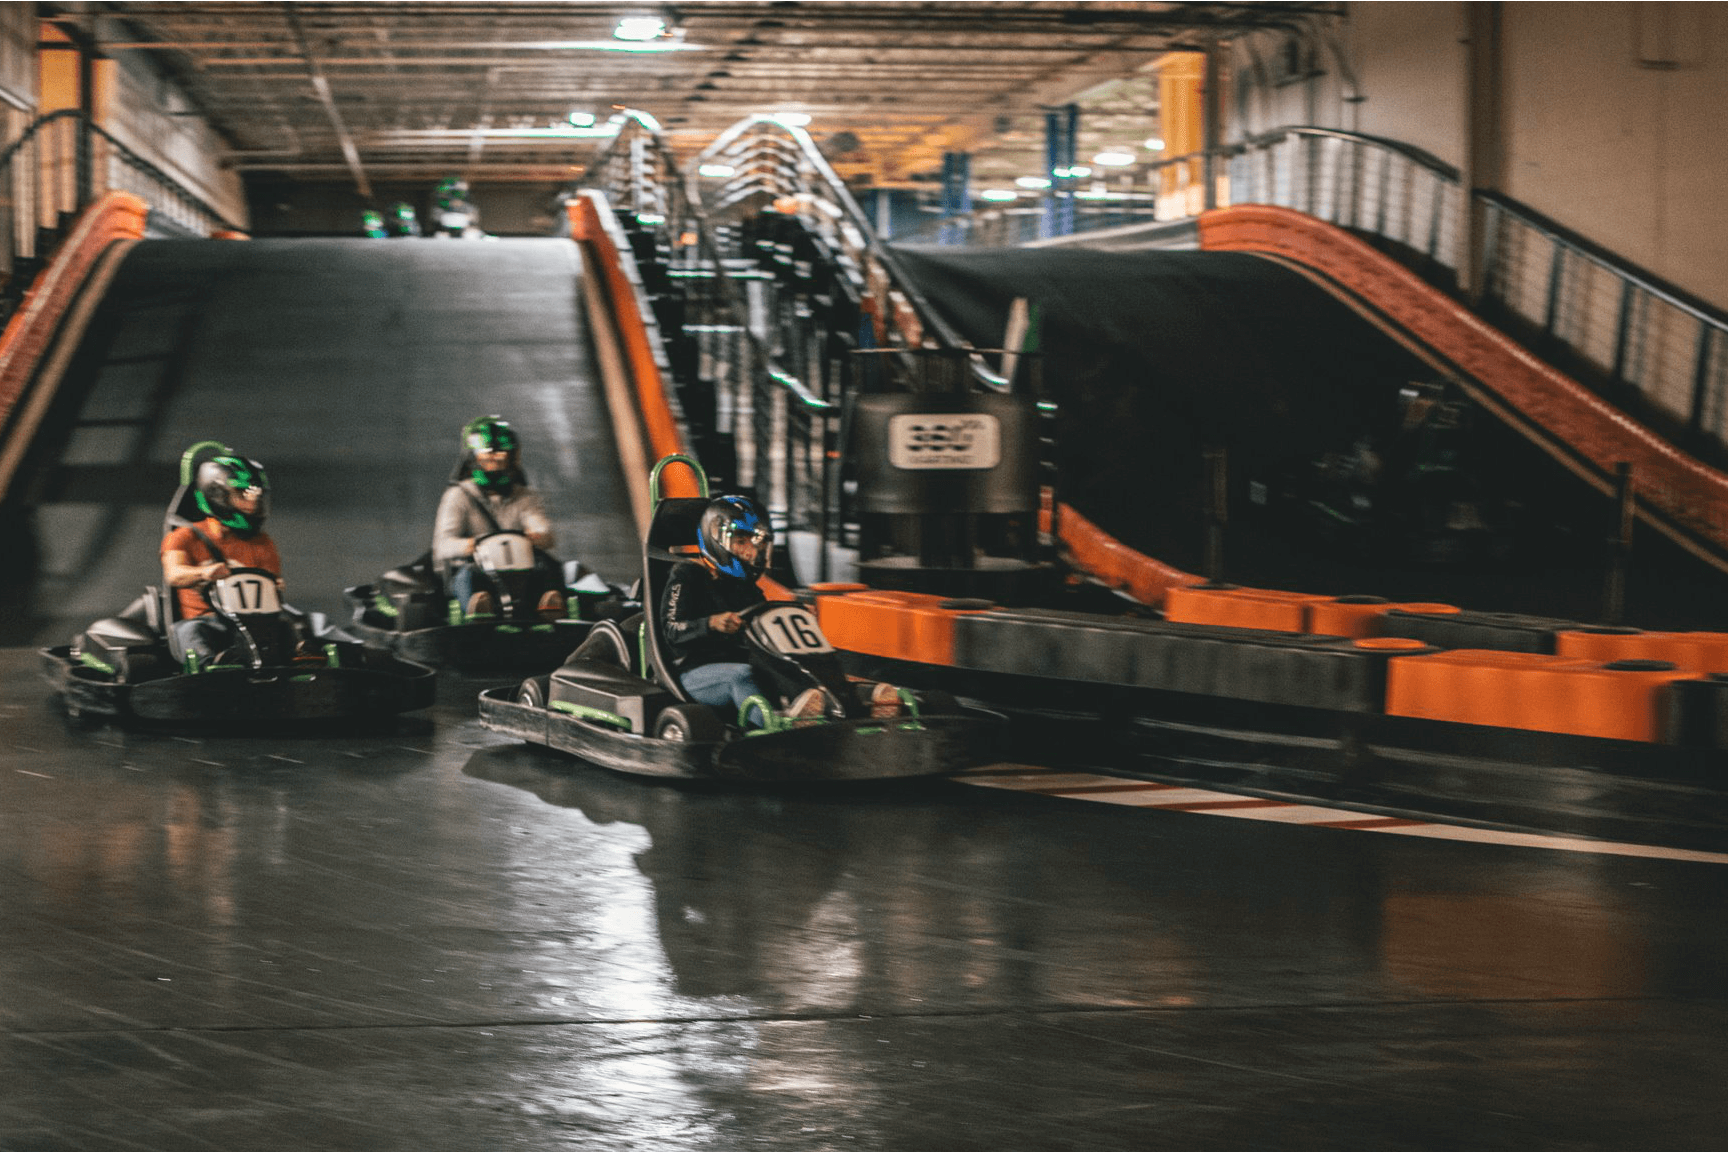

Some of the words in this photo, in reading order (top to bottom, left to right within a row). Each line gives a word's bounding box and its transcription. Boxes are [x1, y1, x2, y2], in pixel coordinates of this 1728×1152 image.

[500, 540, 514, 565] 1
[231, 580, 263, 610] 17
[771, 613, 823, 650] 16
